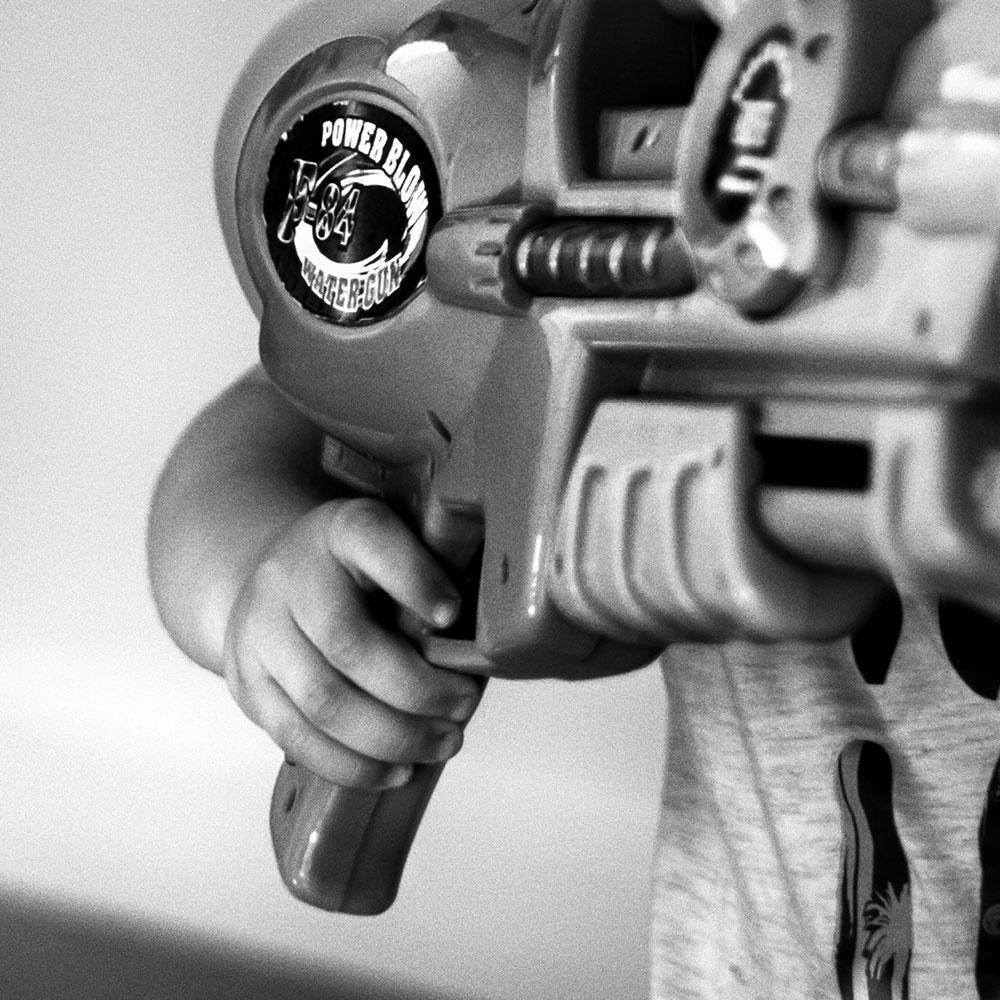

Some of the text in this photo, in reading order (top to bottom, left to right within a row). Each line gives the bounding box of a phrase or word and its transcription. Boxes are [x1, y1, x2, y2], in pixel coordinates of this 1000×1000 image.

[321, 118, 388, 163] POWER
[301, 254, 403, 312] WATER GUN
